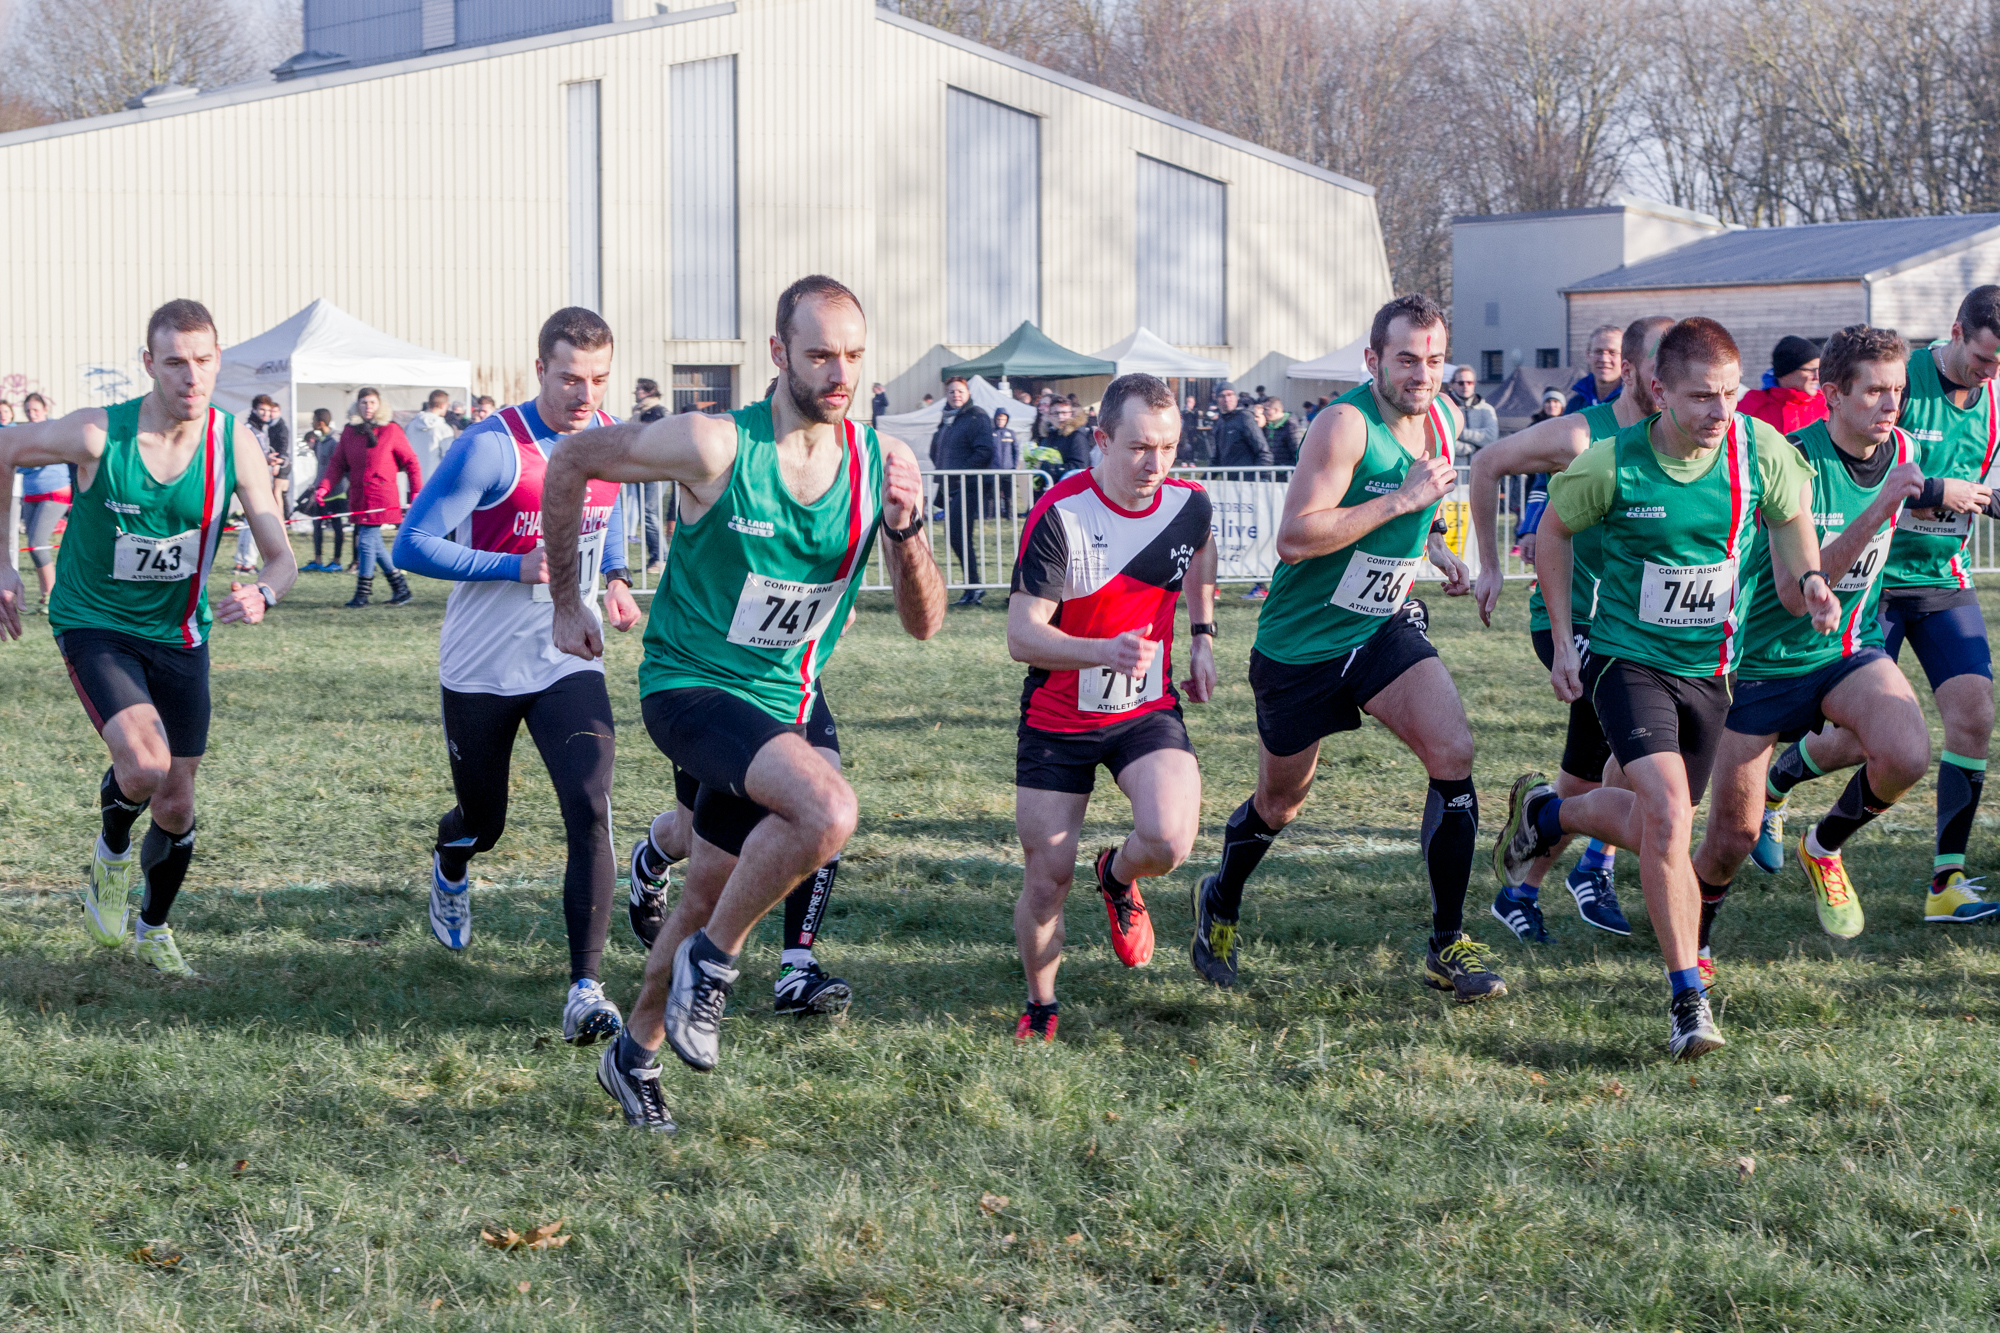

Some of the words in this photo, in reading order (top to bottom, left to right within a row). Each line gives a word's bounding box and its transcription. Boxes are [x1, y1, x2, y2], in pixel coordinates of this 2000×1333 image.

[513, 511, 543, 536] CHA
[731, 523, 771, 536] ATHLE
[732, 515, 746, 525] FC
[747, 519, 774, 530] LAON
[1913, 525, 1956, 533] ATHLETISME
[136, 545, 182, 572] 743
[578, 548, 594, 584] 11
[1367, 556, 1395, 567] COMITE
[1847, 548, 1878, 578] 40
[1659, 567, 1695, 575] COMITE
[1696, 565, 1723, 574] AISNE
[763, 580, 804, 593] COMITE
[806, 585, 833, 594] AISNE
[1358, 569, 1406, 603] 736
[1834, 581, 1868, 590] HLETISME
[1663, 580, 1715, 612] 744
[759, 595, 821, 634] 741
[1349, 602, 1394, 614] ATHLETISME
[1658, 617, 1716, 625] ATHLETISME
[1097, 695, 1148, 711] ATHLETISME
